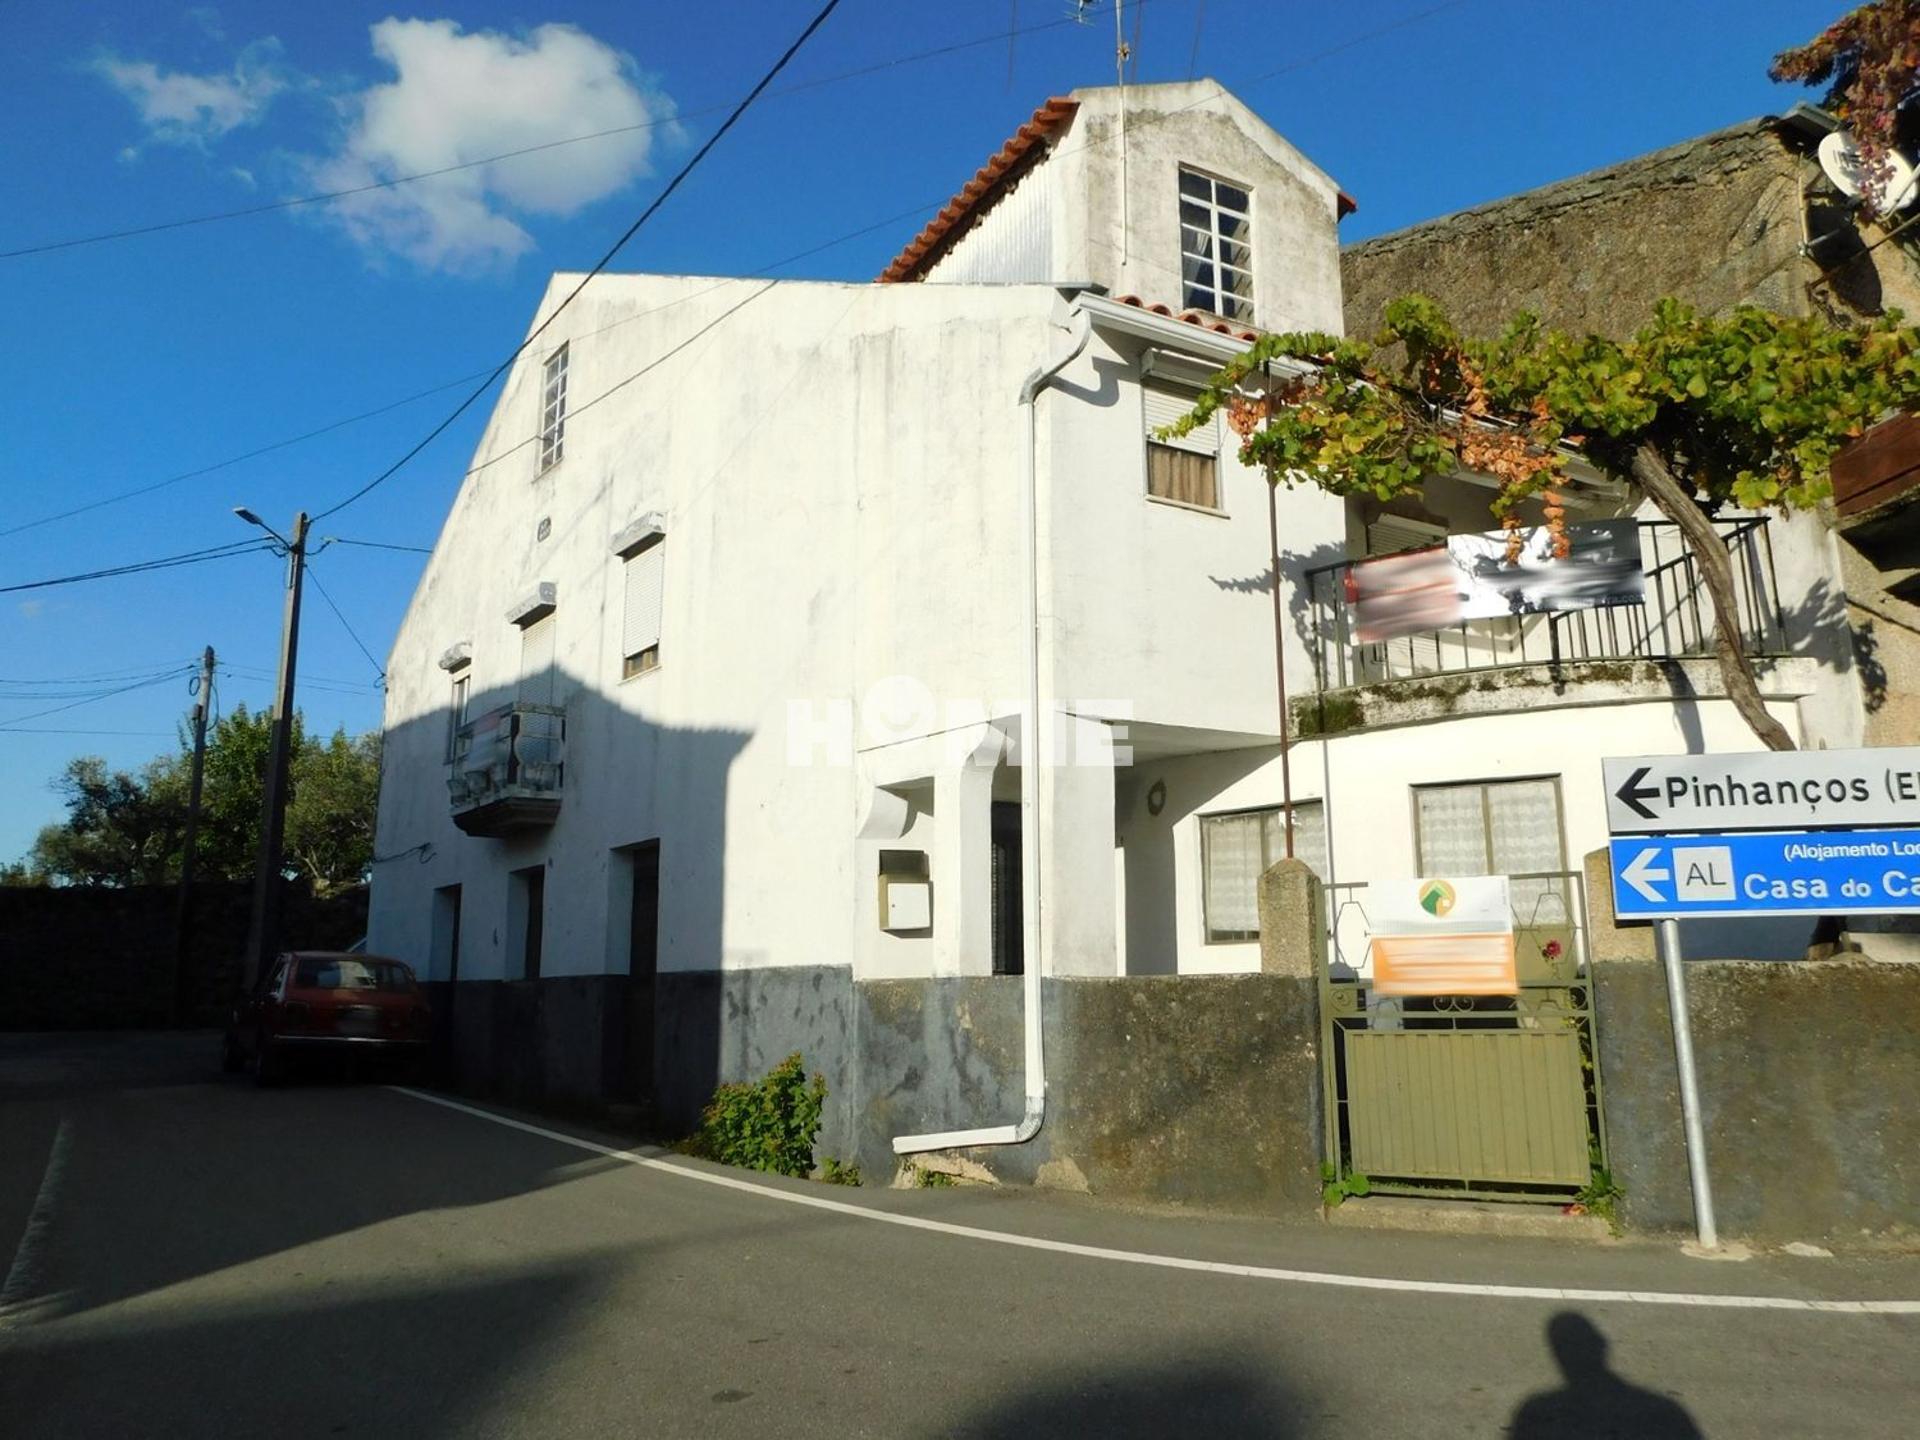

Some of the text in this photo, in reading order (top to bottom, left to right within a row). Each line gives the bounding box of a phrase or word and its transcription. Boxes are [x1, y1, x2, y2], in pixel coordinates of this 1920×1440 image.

[1665, 768, 1920, 814] Pinhanços (E
[1784, 842, 1889, 862] (Alojamento
[1686, 862, 1727, 886] AL
[1743, 873, 1829, 899] Casa
[1841, 878, 1872, 897] do
